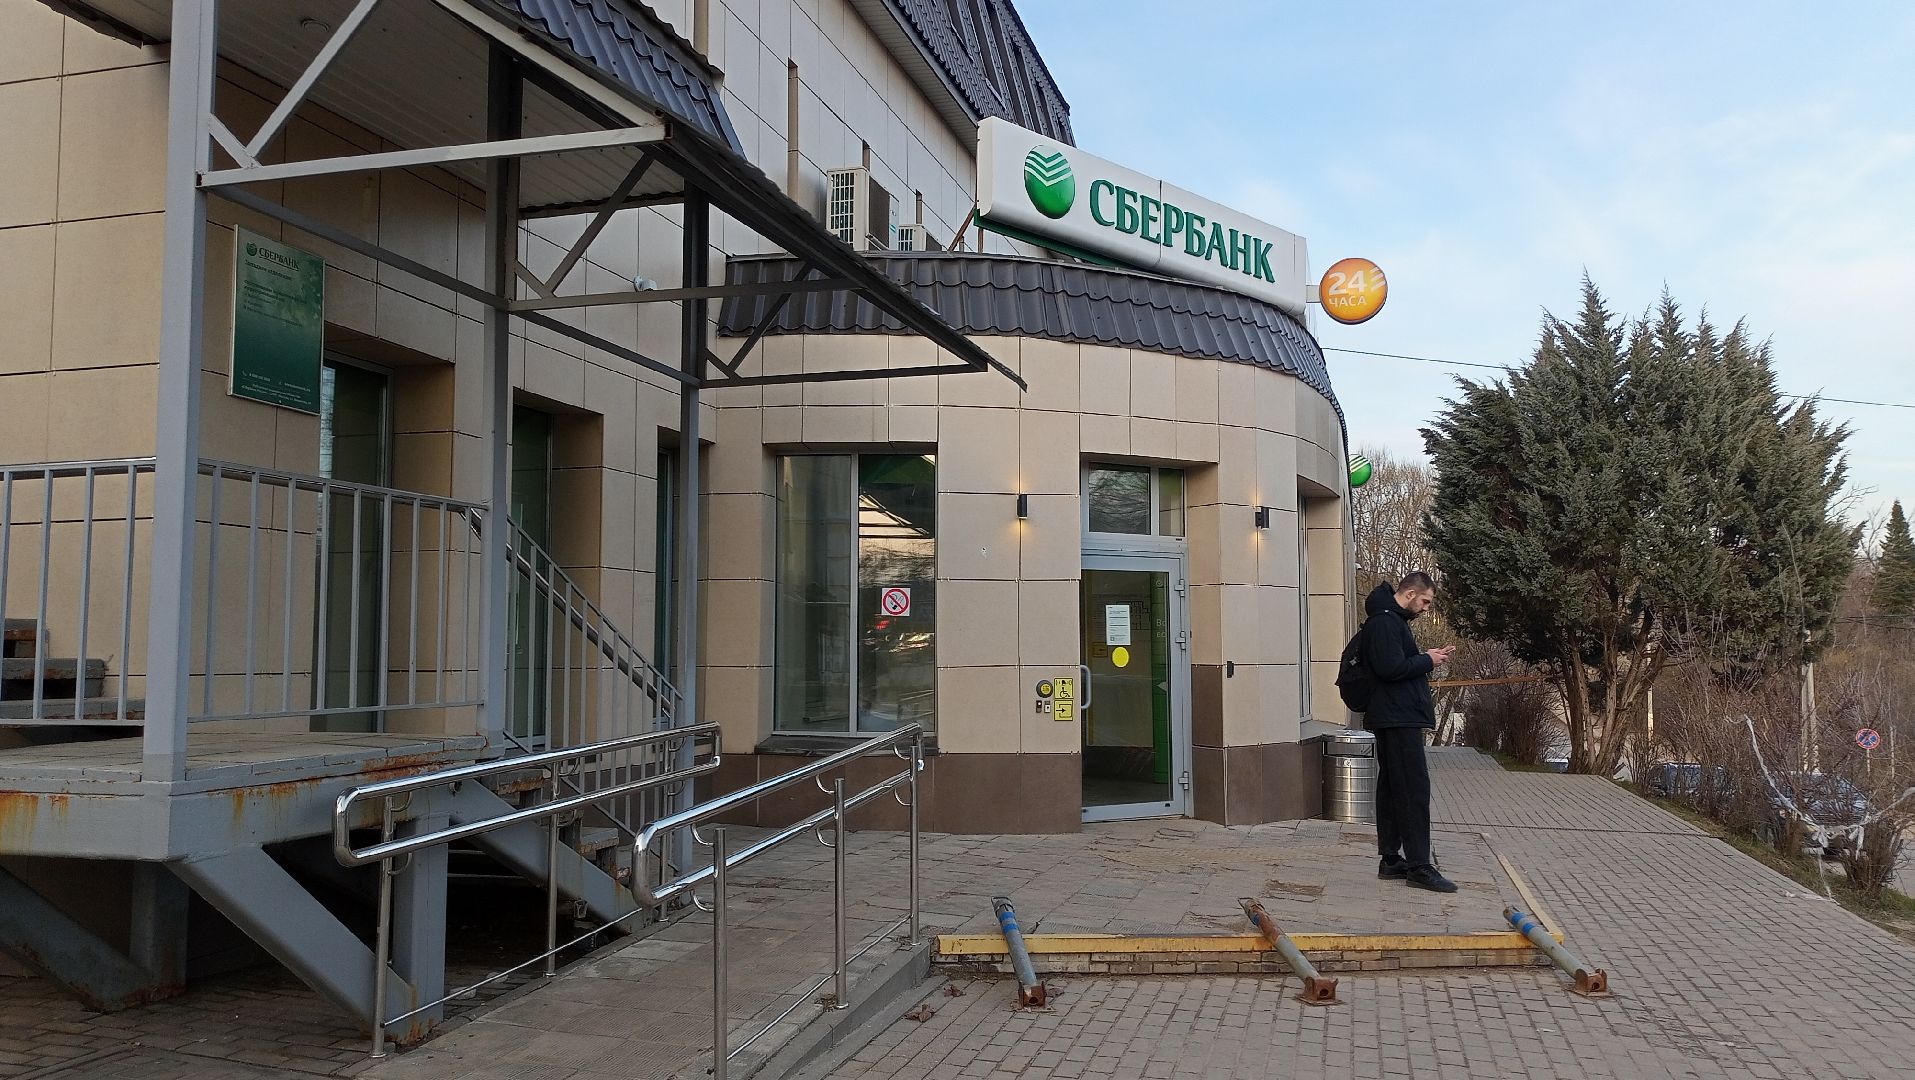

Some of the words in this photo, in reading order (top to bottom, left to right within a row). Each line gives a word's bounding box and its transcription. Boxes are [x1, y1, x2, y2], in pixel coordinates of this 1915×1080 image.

[1089, 179, 1276, 284] СБЕРБАНК
[259, 247, 300, 270] СБЕРБАНК
[1328, 270, 1367, 295] 24
[1328, 295, 1367, 307] ЧАСА
